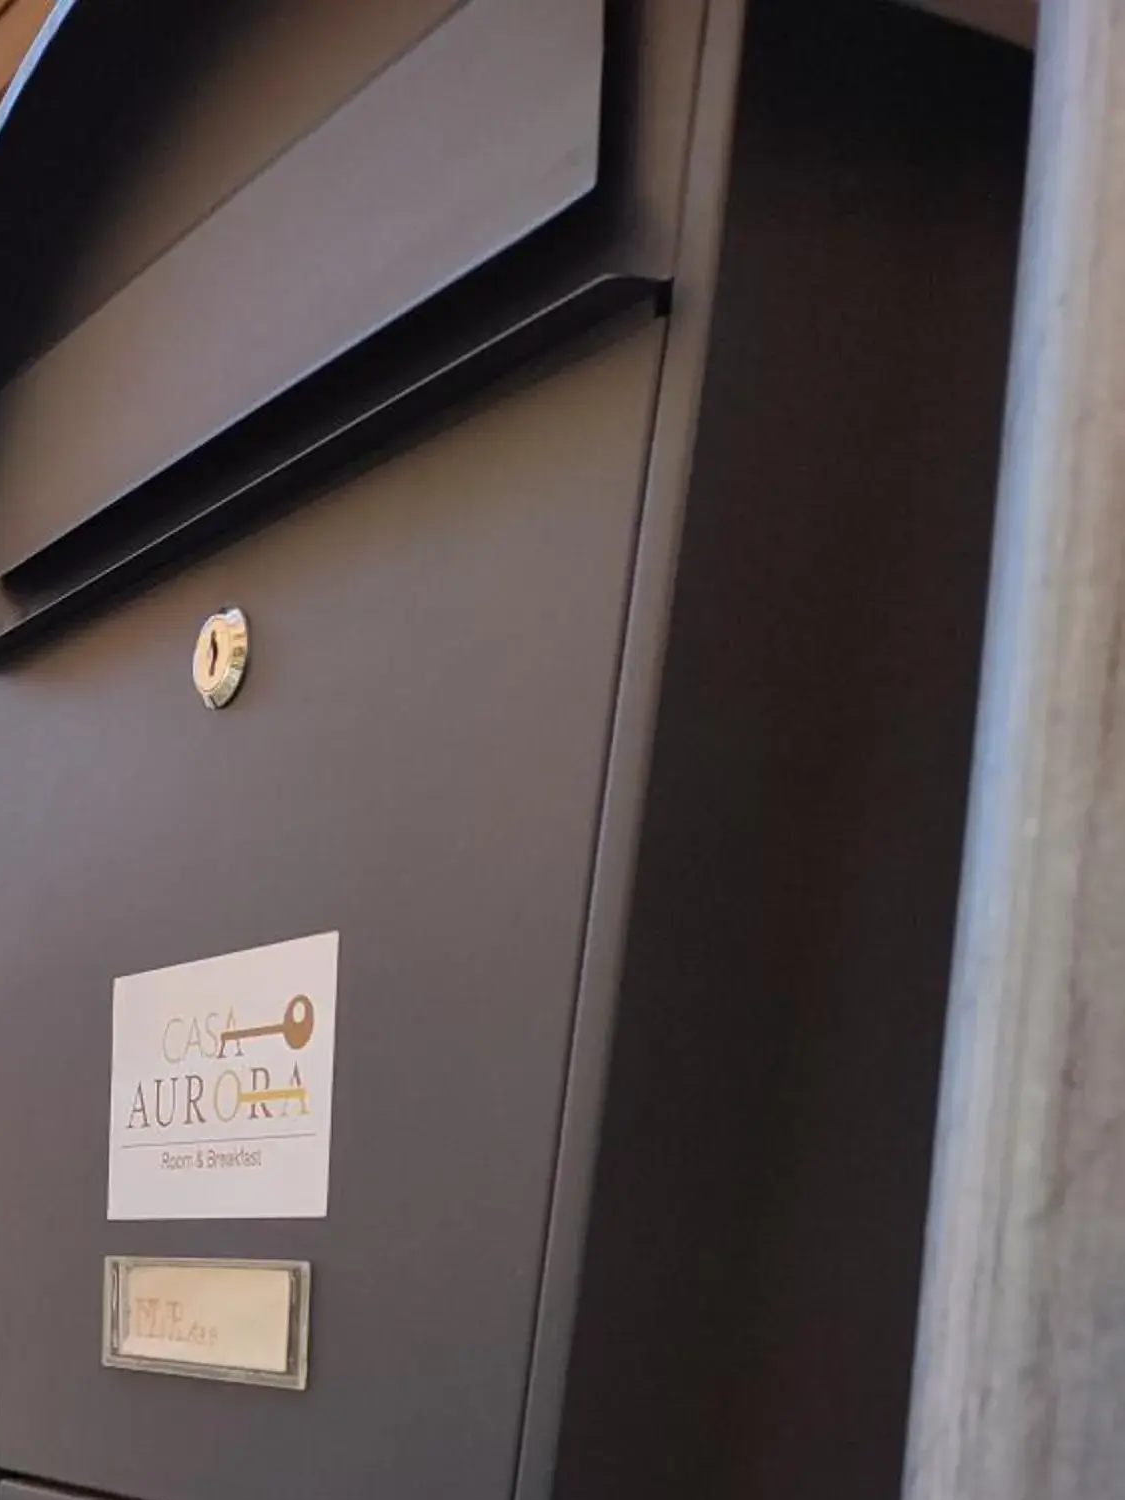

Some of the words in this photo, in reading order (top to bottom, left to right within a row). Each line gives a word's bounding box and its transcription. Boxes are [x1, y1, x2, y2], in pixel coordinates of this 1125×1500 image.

[162, 1006, 244, 1064] CASA
[127, 1060, 311, 1129] AURORA
[161, 1151, 193, 1170] Room
[195, 1151, 204, 1169] &
[208, 1148, 262, 1169] Breakfast
